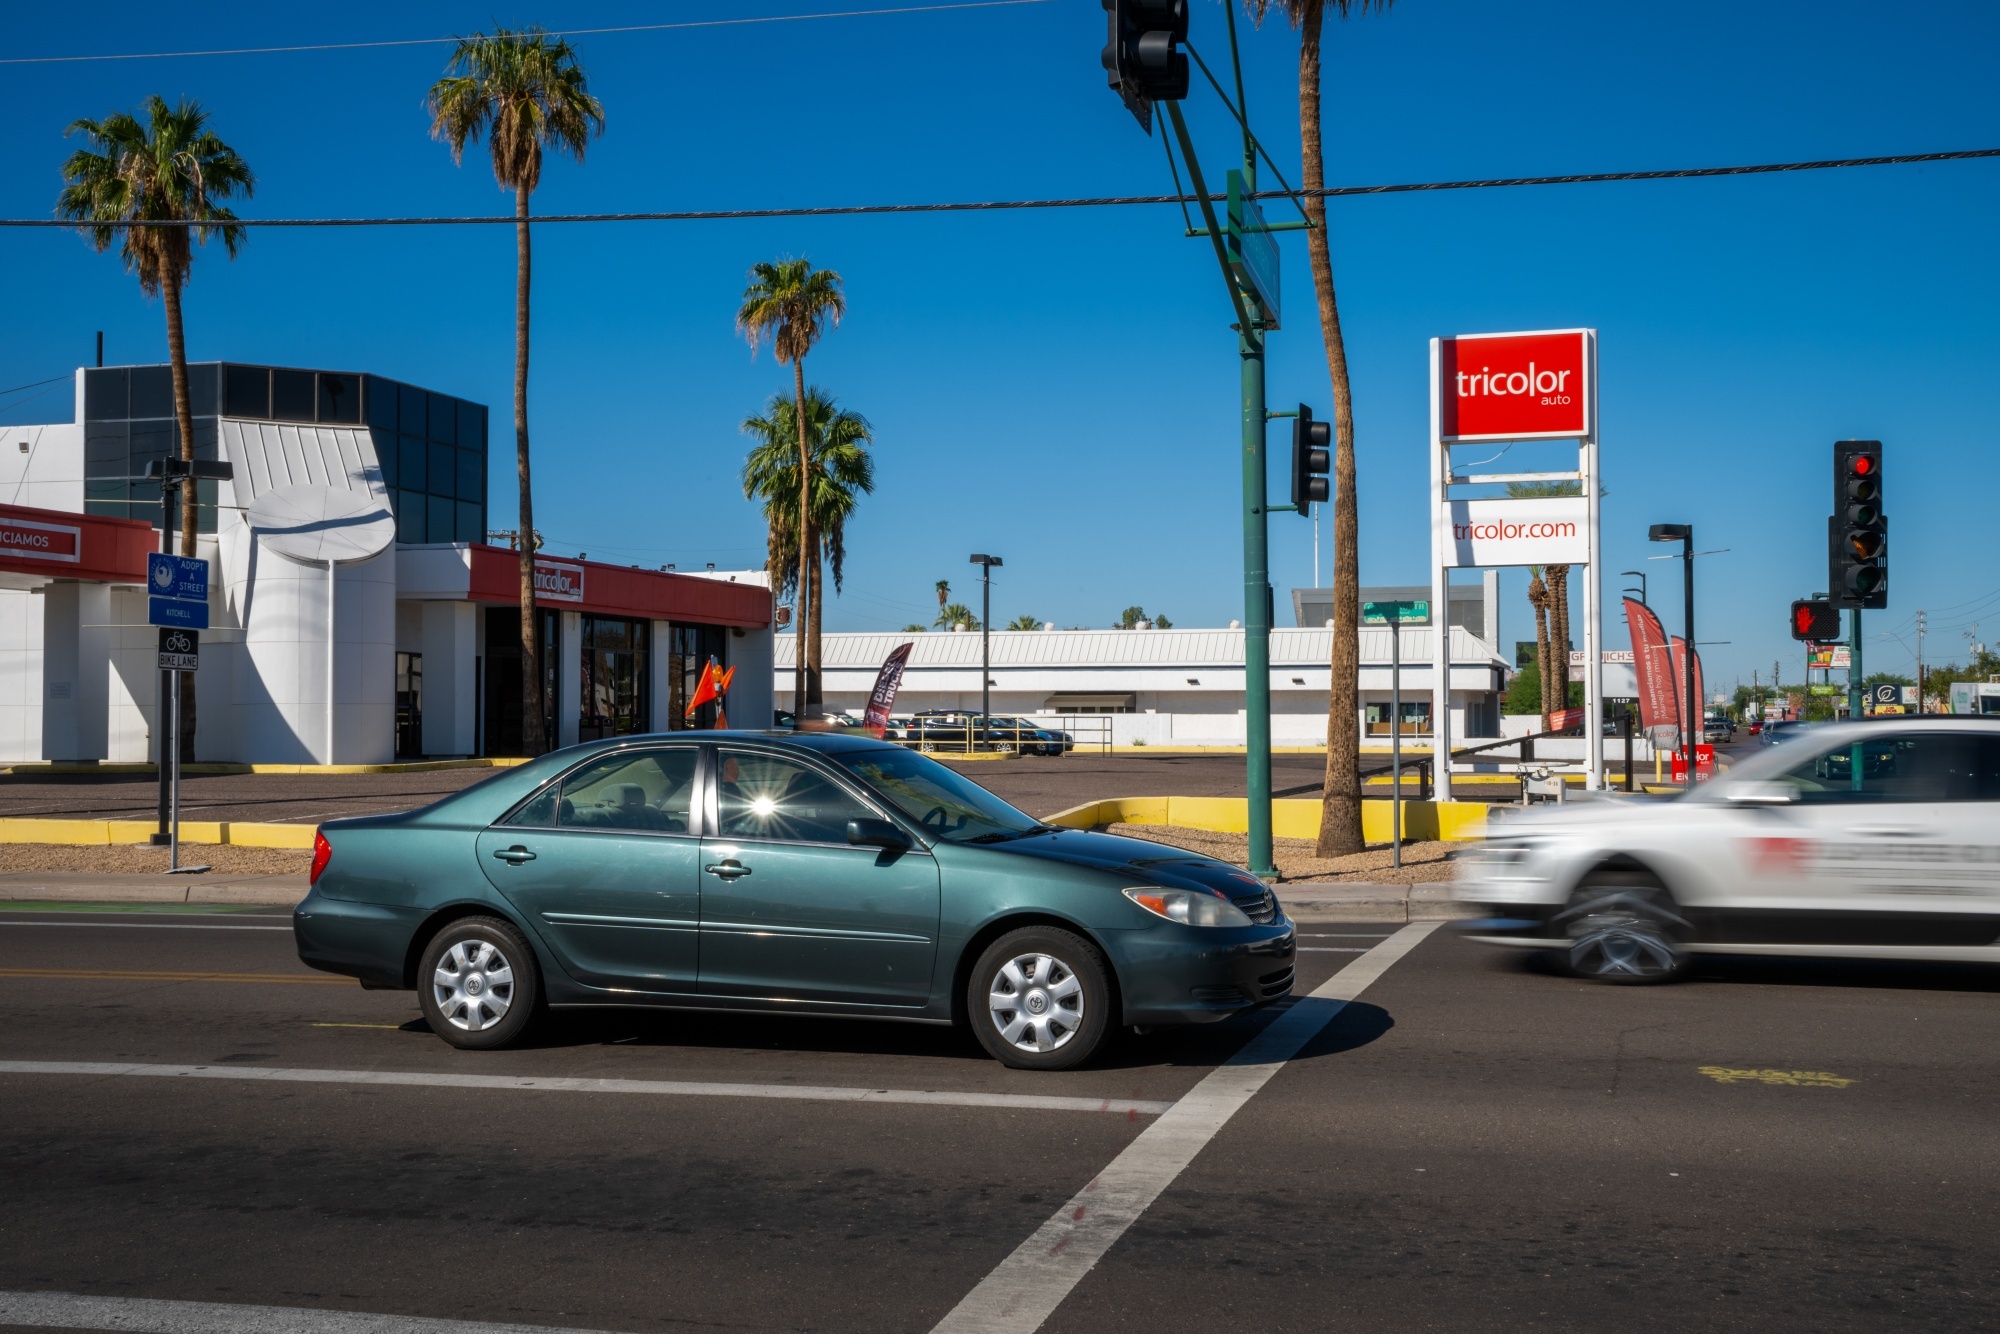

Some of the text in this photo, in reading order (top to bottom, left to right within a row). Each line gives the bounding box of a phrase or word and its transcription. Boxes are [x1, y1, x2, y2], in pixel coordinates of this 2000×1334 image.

[1455, 361, 1571, 397] tricolor
[1541, 395, 1571, 405] auto
[1453, 518, 1576, 541] tricolor.com
[0, 530, 49, 548] CIAMOS
[180, 560, 204, 572] ADOPT
[189, 572, 195, 581] A
[534, 569, 572, 593] tricolor
[179, 581, 205, 593] STREET
[166, 608, 191, 619] KITCHELL
[160, 654, 197, 668] BIKE LANE
[1655, 729, 1675, 739] ricolor
[1675, 772, 1709, 781] ENER
